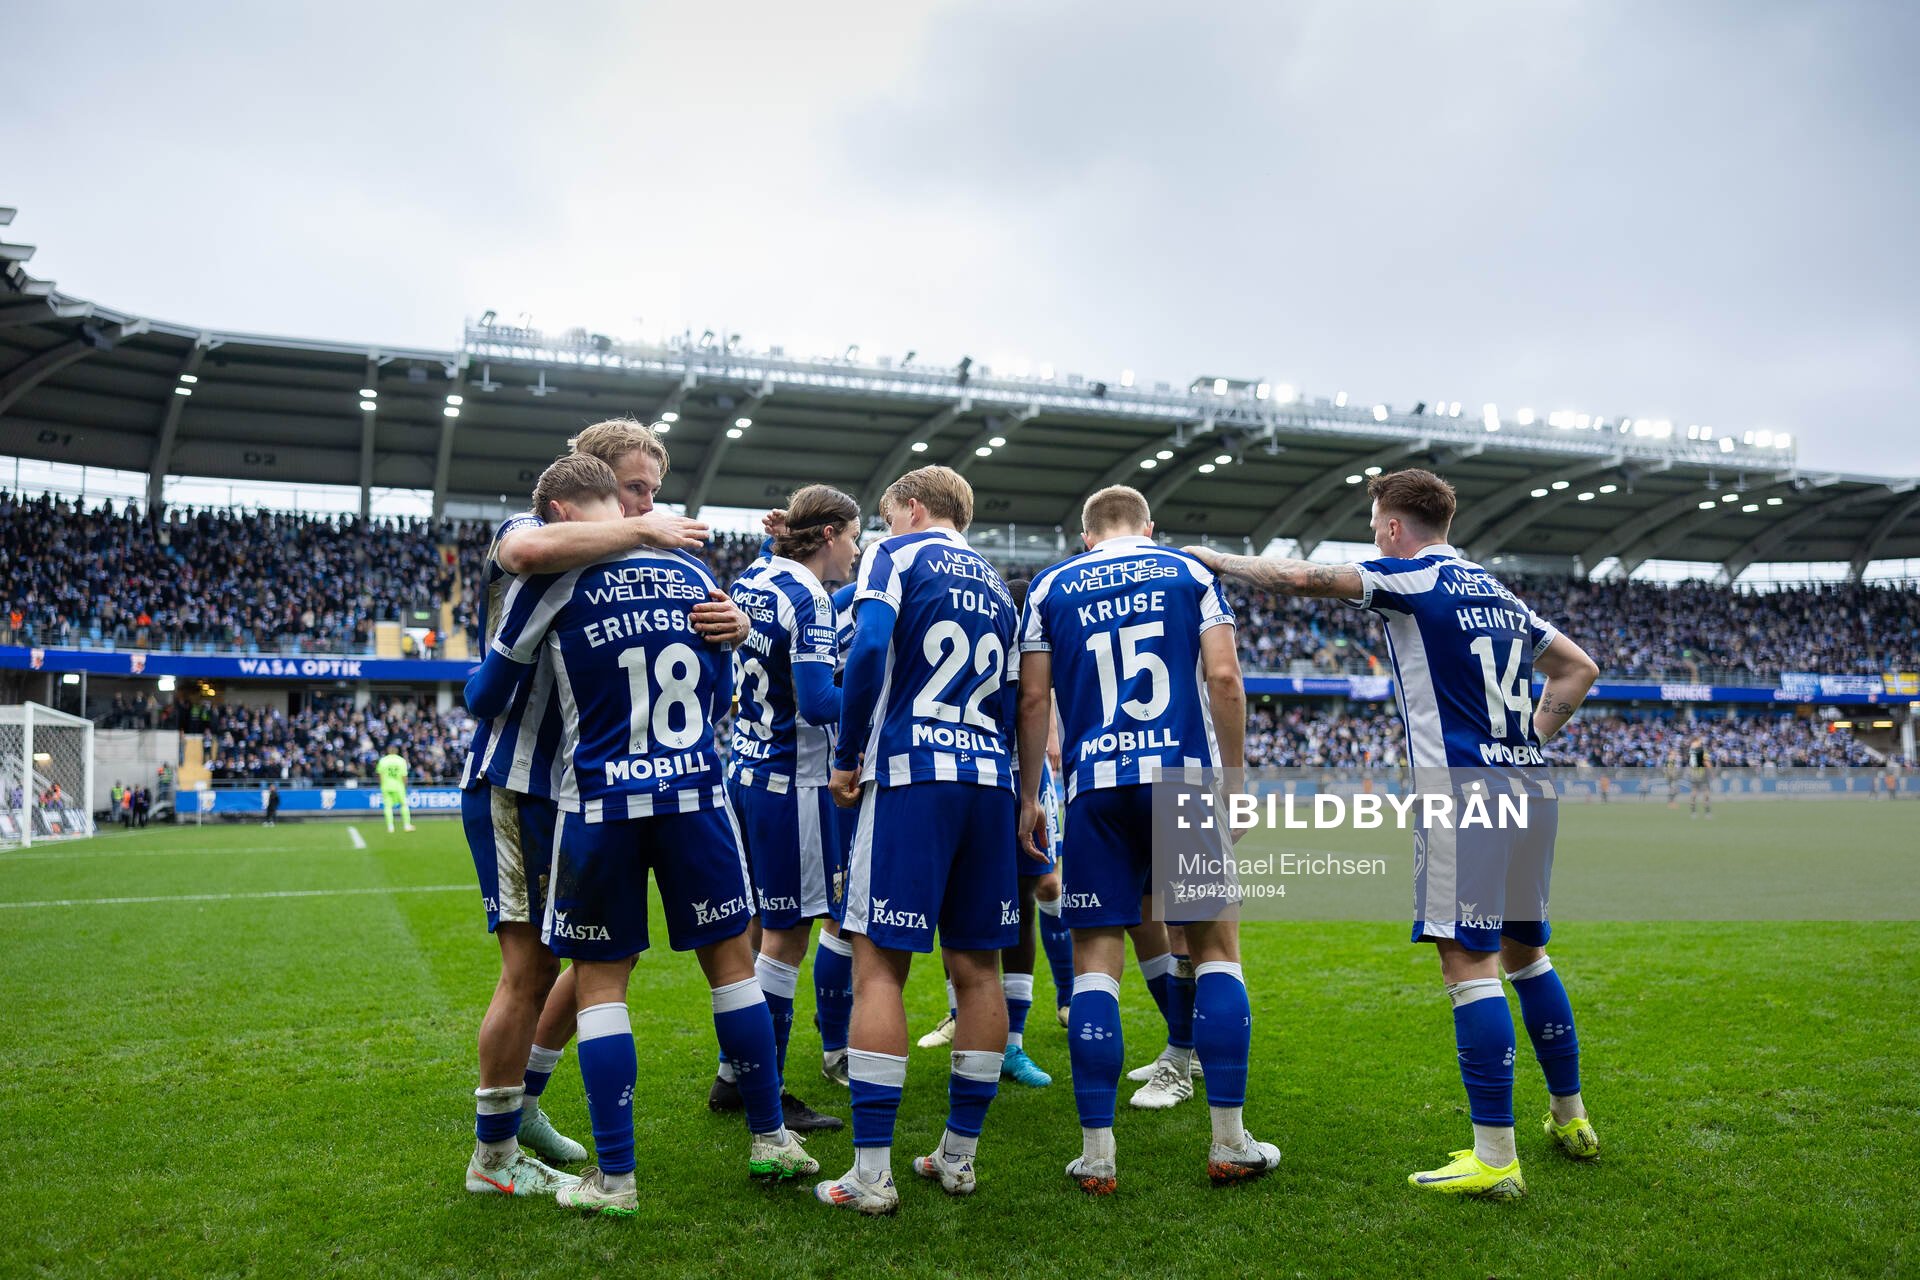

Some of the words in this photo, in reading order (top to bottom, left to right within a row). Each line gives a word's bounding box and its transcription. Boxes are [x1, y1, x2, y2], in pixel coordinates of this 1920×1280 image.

[604, 567, 686, 586] NORDIC
[943, 549, 1001, 580] NORDIC
[1079, 558, 1158, 580] NORDIC
[585, 585, 706, 605] WELLNESS
[927, 560, 1011, 608] WELLNESS
[1061, 567, 1178, 594] WELLNESS
[741, 606, 774, 623] NESS
[1078, 591, 1165, 627] KRUSE
[1456, 607, 1527, 634] HEINTZ
[584, 609, 705, 648] ERIKSS
[807, 628, 836, 640] UNIBET
[238, 659, 298, 675] WASA
[302, 660, 361, 676] OPTIK
[912, 620, 1004, 734] 22
[1086, 621, 1170, 728] 15
[618, 642, 704, 754] 18
[1470, 636, 1532, 740] 14
[912, 724, 1006, 755] MOBILL
[1081, 728, 1180, 761] MOBILL
[605, 752, 711, 786] MOBILL
[697, 895, 748, 926] RASTA
[759, 896, 799, 911] RASTA
[1001, 908, 1020, 925] RAS
[554, 920, 611, 941] RASTA
[872, 908, 929, 929] RASTA
